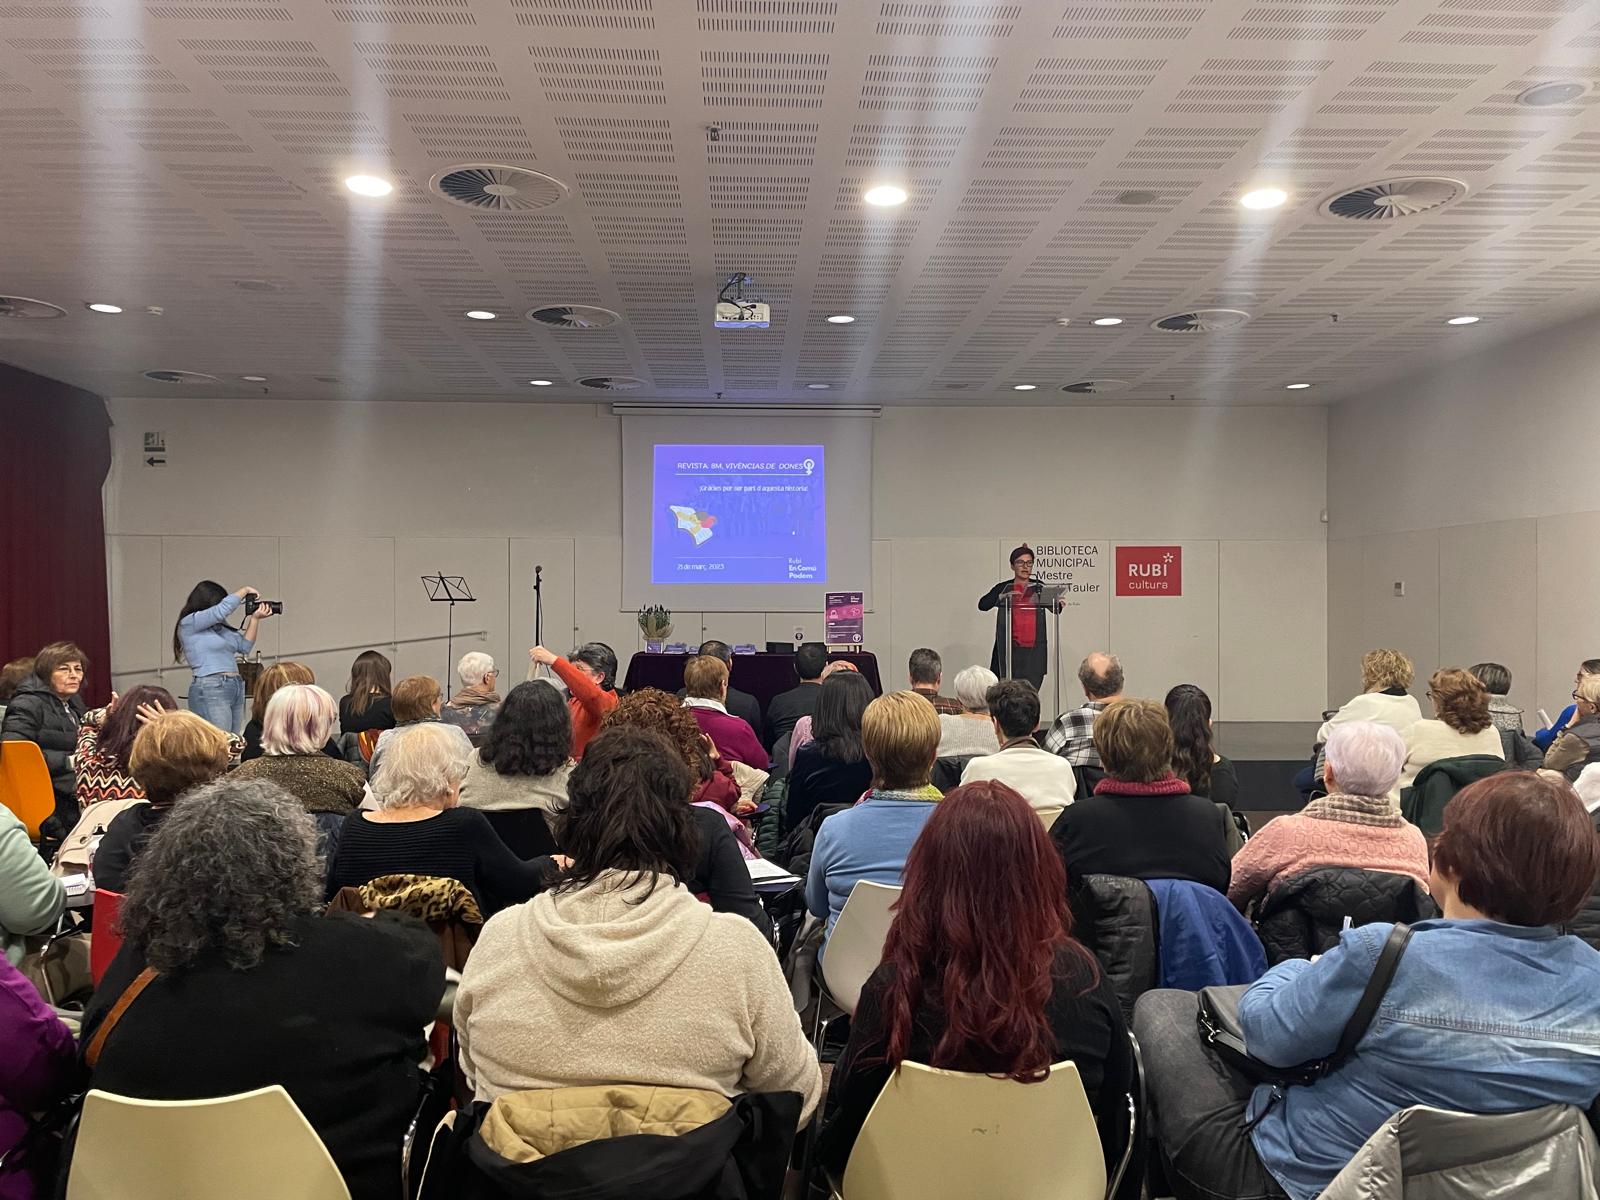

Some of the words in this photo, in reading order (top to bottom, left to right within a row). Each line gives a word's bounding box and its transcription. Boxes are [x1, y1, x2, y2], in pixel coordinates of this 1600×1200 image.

[765, 462, 776, 470] DE
[1036, 545, 1098, 555] BIBLIOTECA
[1036, 558, 1095, 568] MUNICIPAL
[1036, 571, 1073, 580] Mestre
[1067, 583, 1100, 593] Tauler
[1128, 580, 1168, 590] cultura
